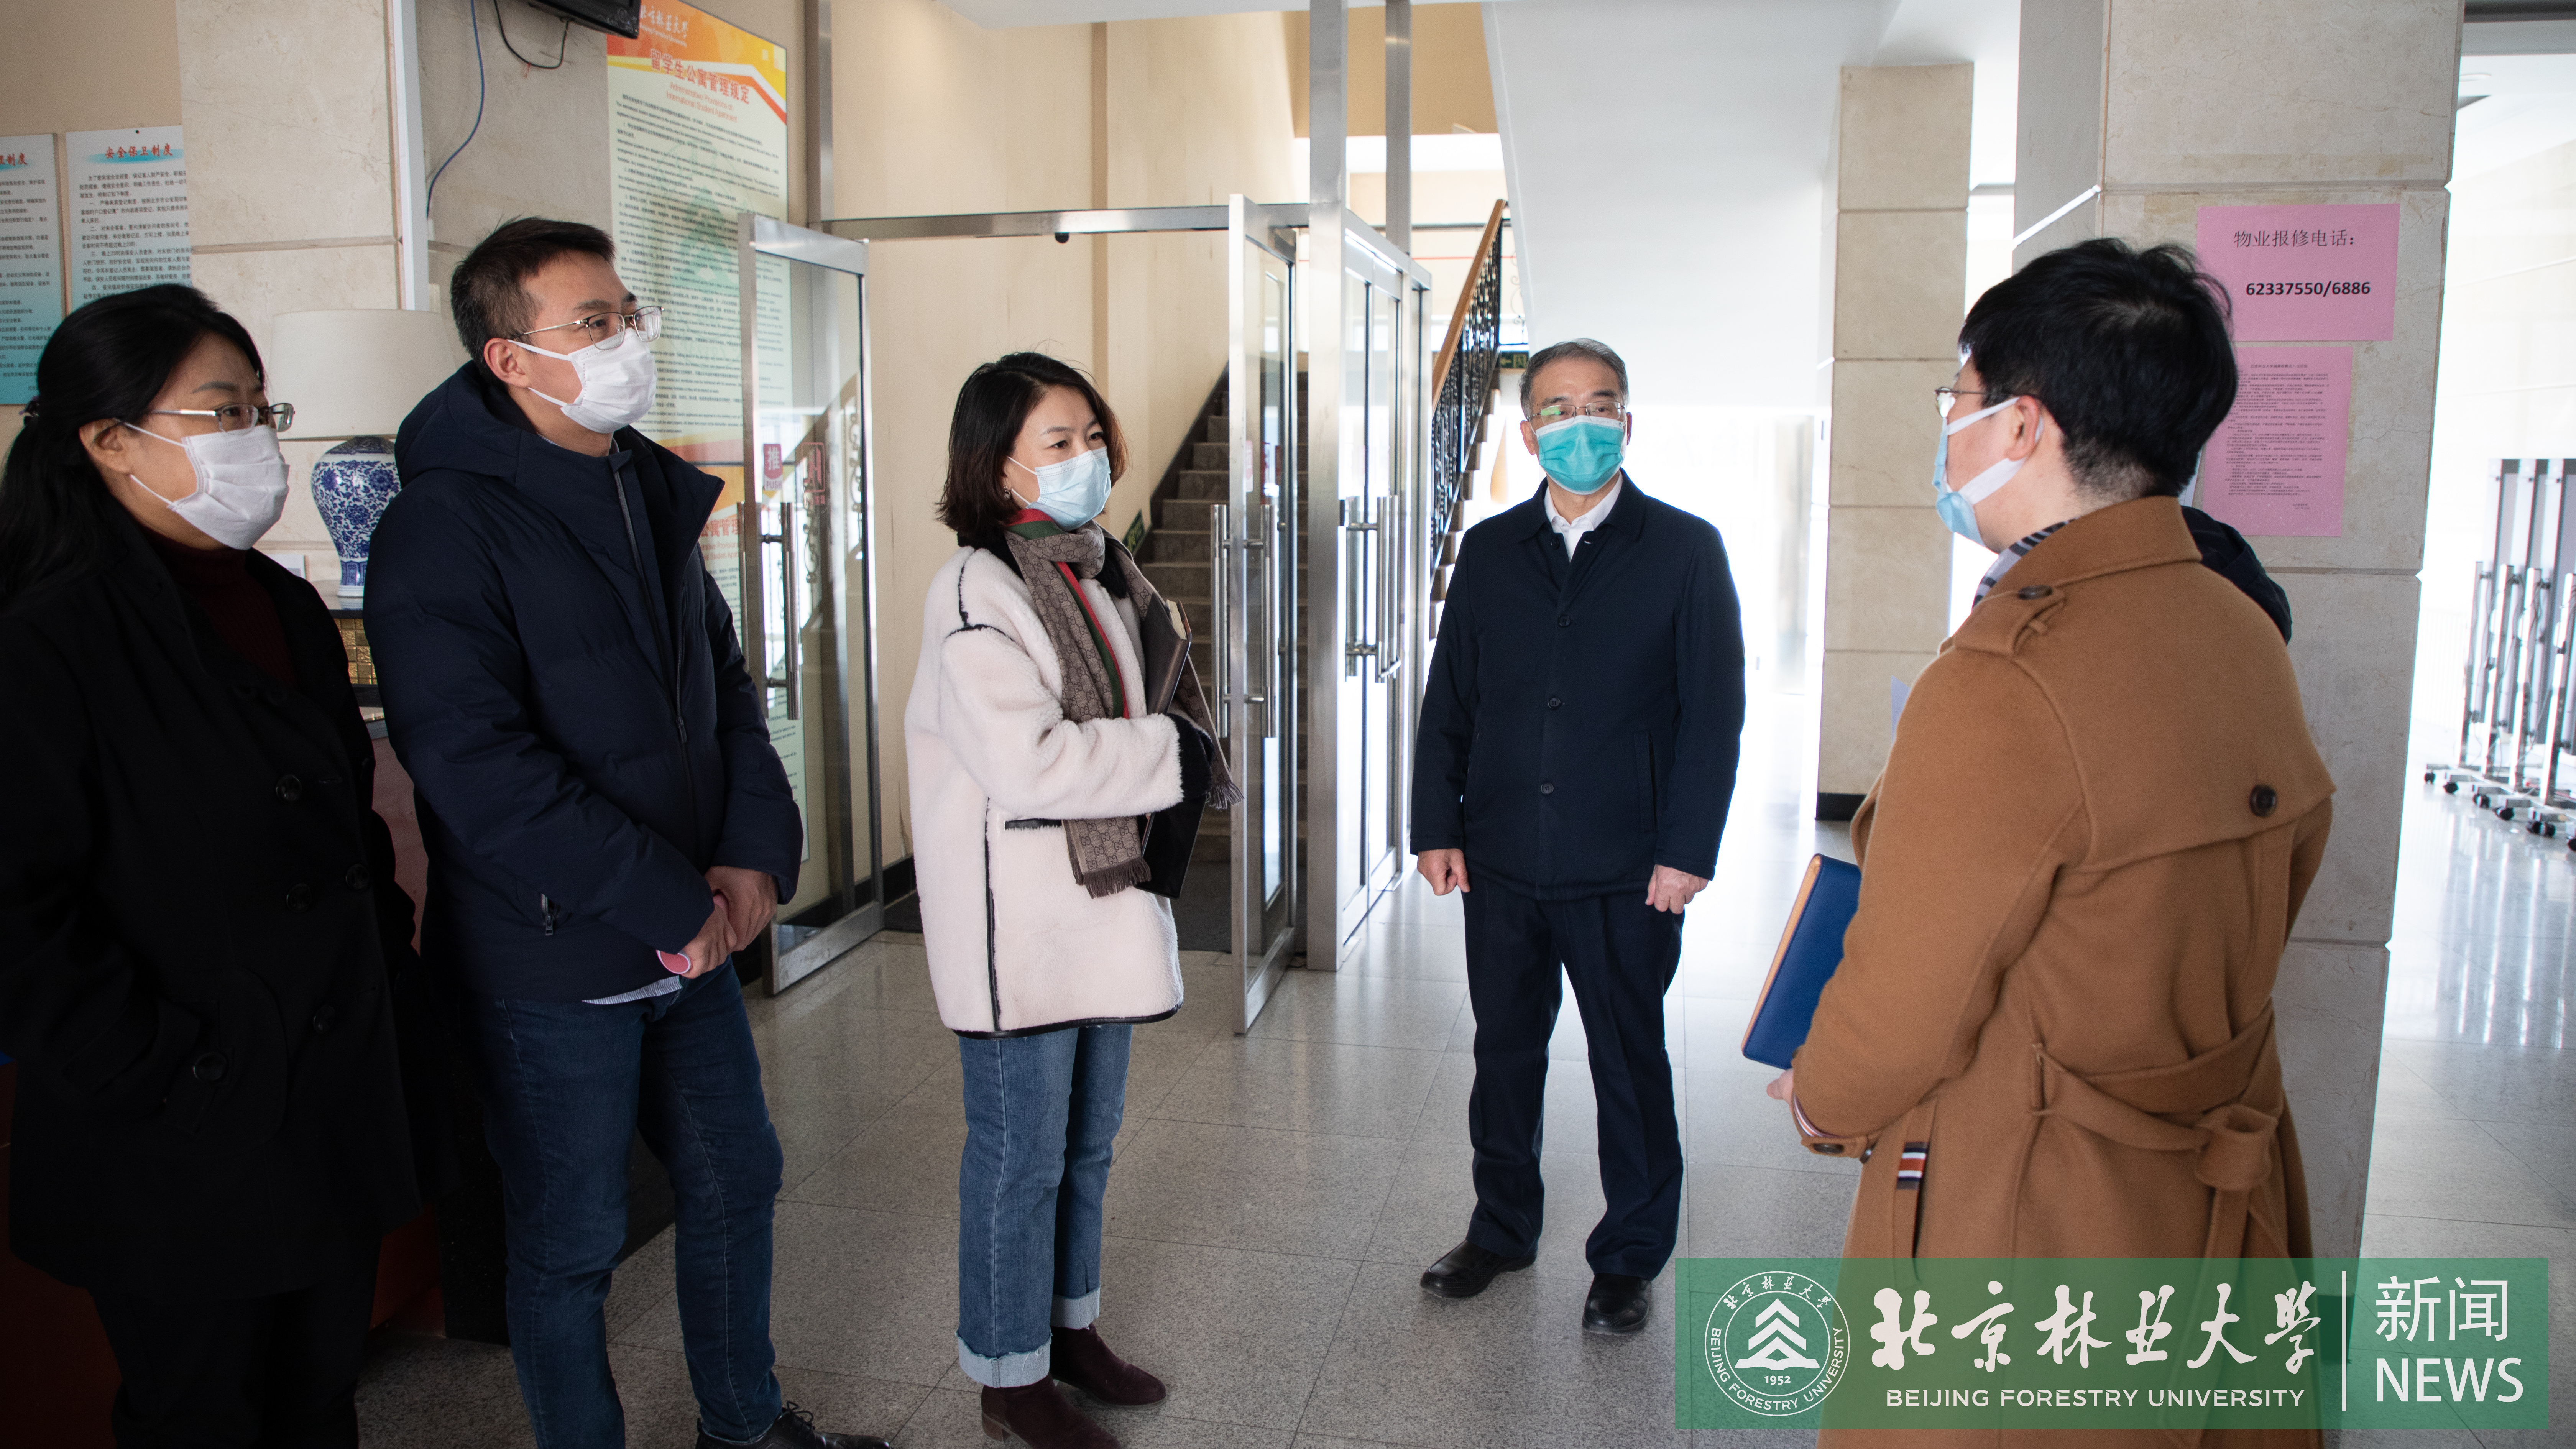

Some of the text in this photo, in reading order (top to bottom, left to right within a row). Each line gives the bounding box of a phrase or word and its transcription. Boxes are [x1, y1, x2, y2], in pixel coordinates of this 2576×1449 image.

[650, 48, 750, 105] 留学生公寓管理规定
[670, 82, 703, 100] Administrative
[704, 94, 728, 109] Provisions
[666, 91, 738, 123] International Student Apartment
[105, 143, 173, 159] 安全保卫制度
[2246, 281, 2371, 297] 62337550/6886
[767, 446, 780, 471] 推
[766, 481, 782, 489] PUSH
[710, 552, 727, 560] Student
